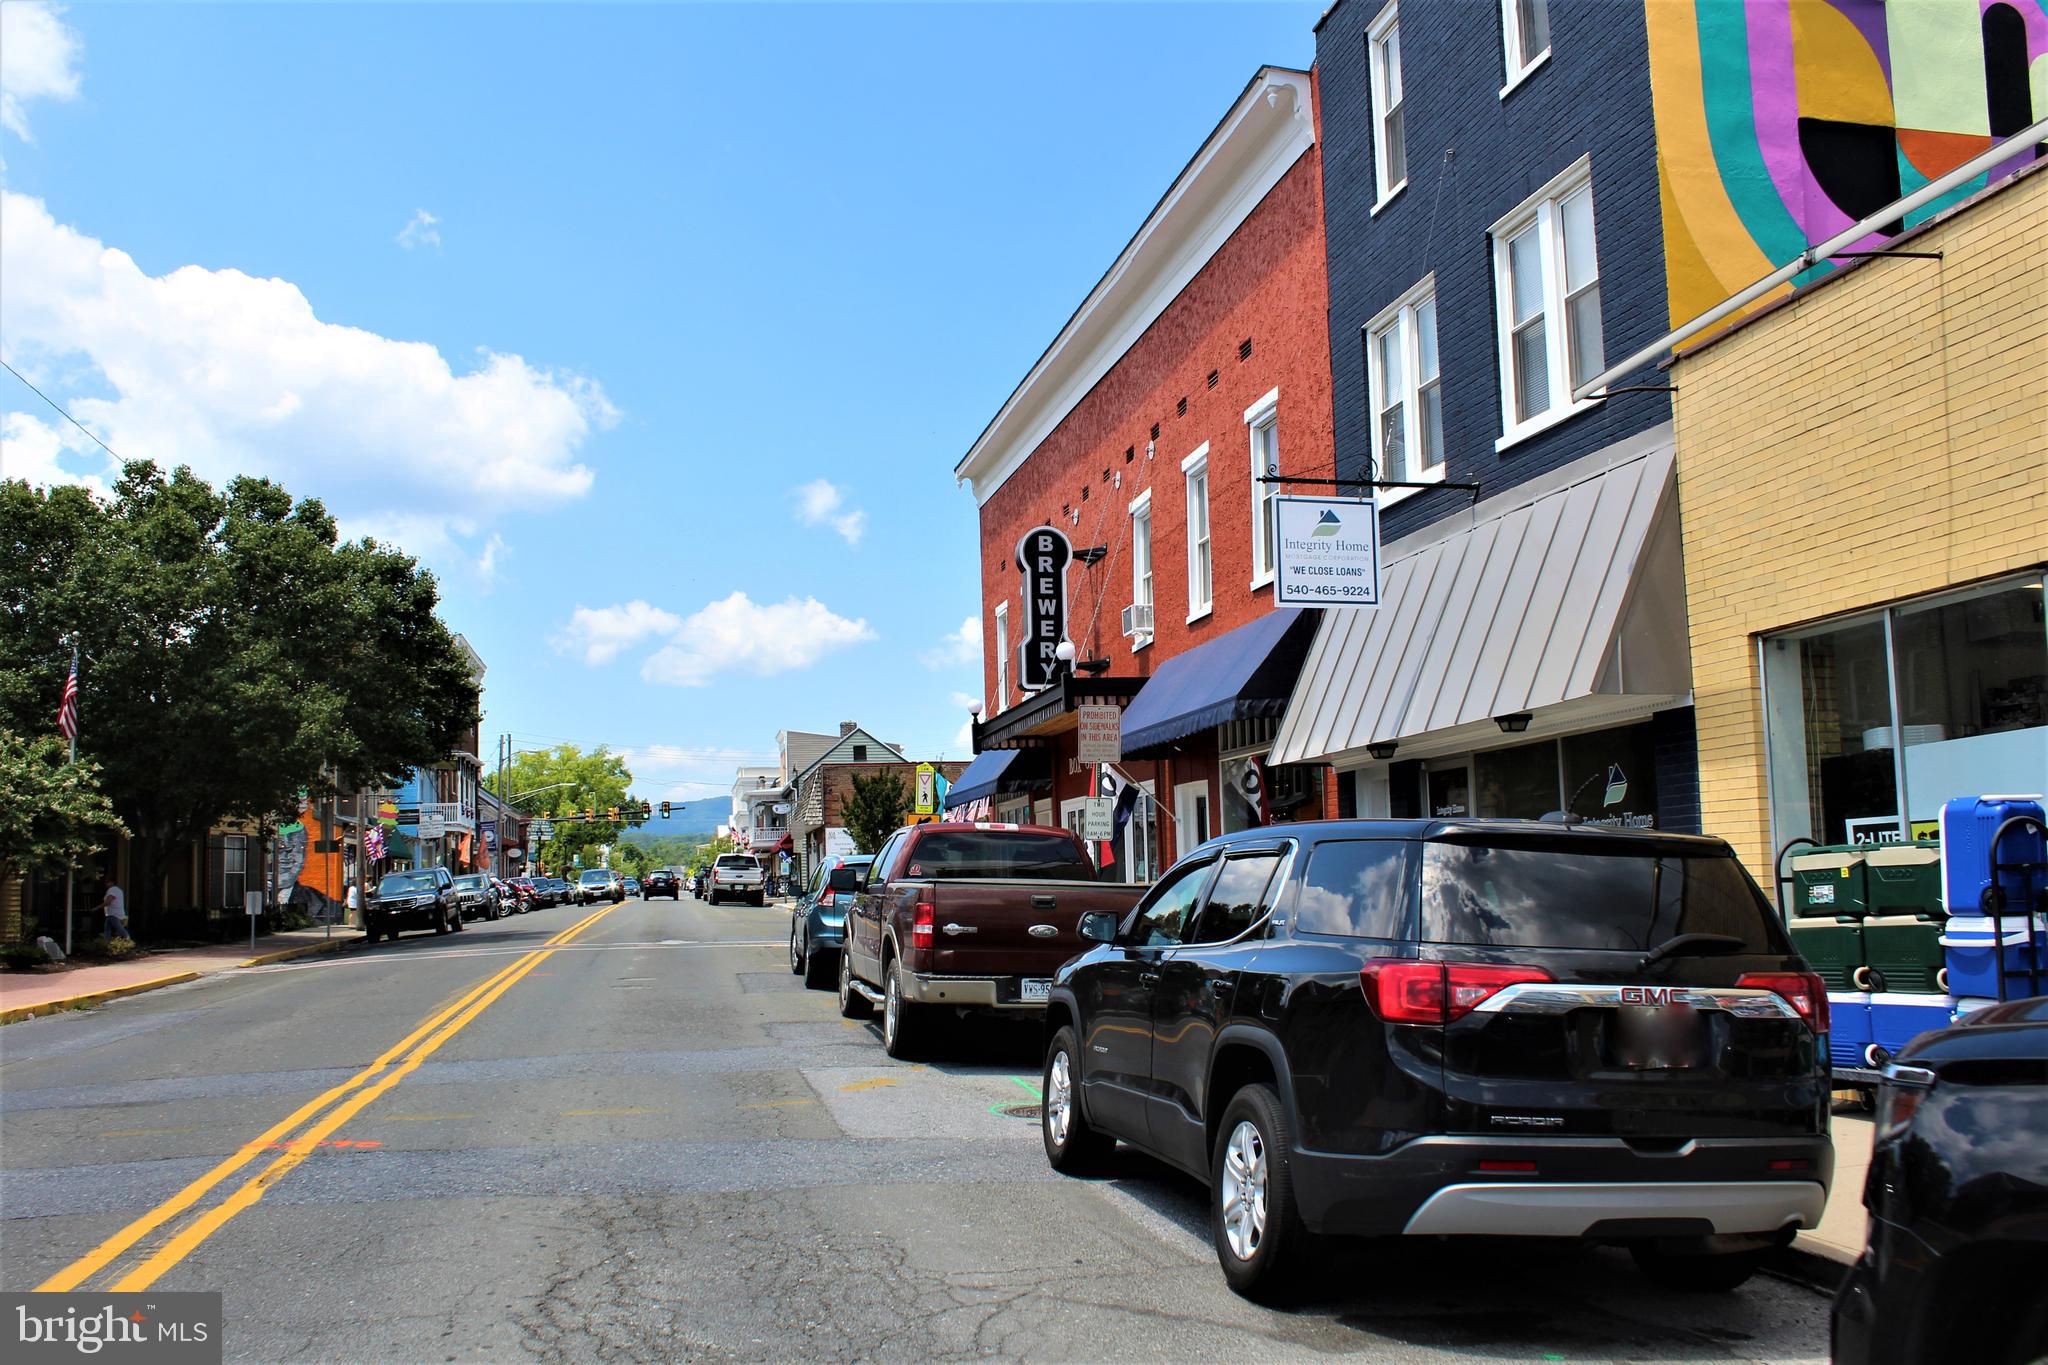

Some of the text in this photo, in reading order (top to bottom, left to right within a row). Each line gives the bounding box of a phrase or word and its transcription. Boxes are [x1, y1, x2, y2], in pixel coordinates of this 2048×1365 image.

[1285, 538, 1369, 553] Integrity Home
[1308, 566, 1334, 576] CLOSE
[1286, 585, 1370, 596] 540-465-9224
[1038, 535, 1056, 680] BREWERY
[1082, 711, 1117, 720] PROHIBITED
[1080, 722, 1120, 731] ON SIDEWALKS
[1080, 733, 1118, 742] IN THIS AREA
[1623, 811, 1654, 829] Home
[1621, 988, 1690, 1005] GMC
[1491, 1115, 1565, 1126] ACADIA
